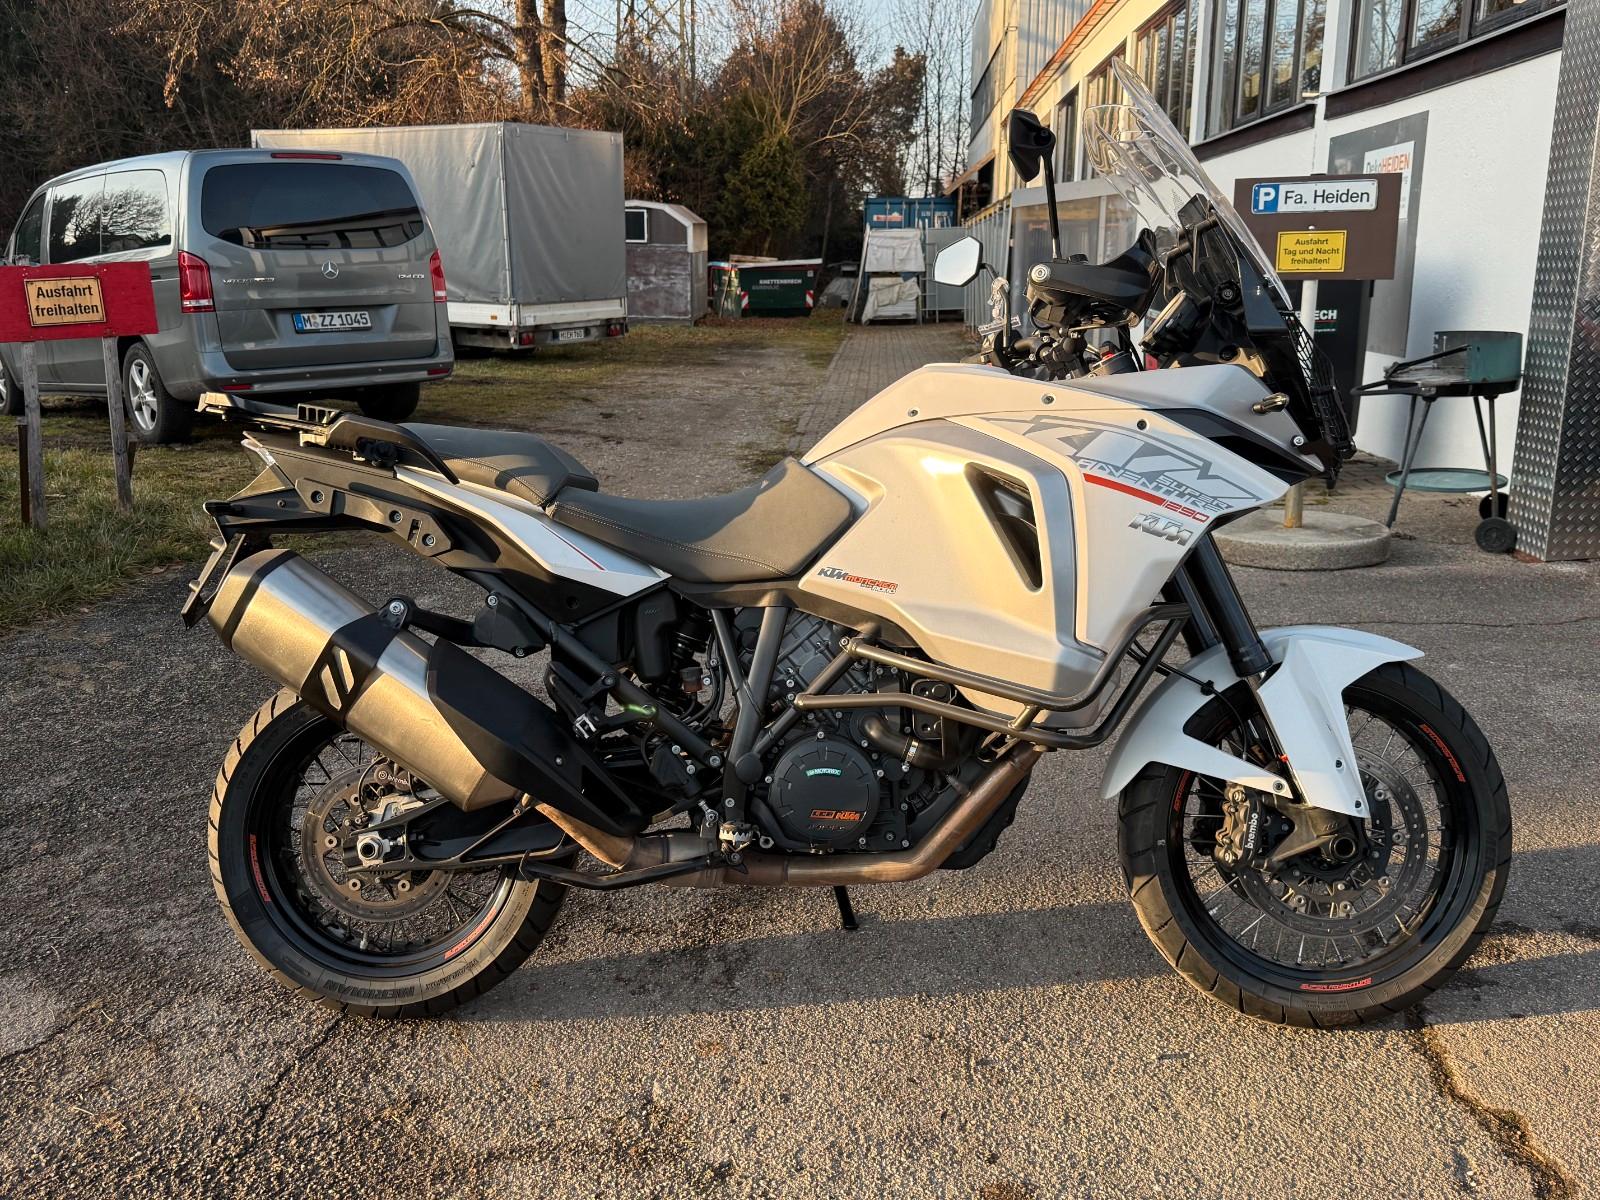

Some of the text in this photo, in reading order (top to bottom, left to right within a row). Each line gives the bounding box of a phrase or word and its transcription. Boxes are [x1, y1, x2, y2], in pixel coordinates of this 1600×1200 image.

[1258, 187, 1370, 210] P Fa. Heiden
[1284, 248, 1297, 256] Tag
[36, 284, 93, 299] Ausfahrt
[35, 303, 99, 317] freihalten
[302, 312, 368, 328] M ZZ 1045
[1078, 458, 1226, 513] ADVENTURE
[1128, 513, 1194, 547] KTM
[817, 567, 849, 580] KTM
[1244, 812, 1259, 849] brembo
